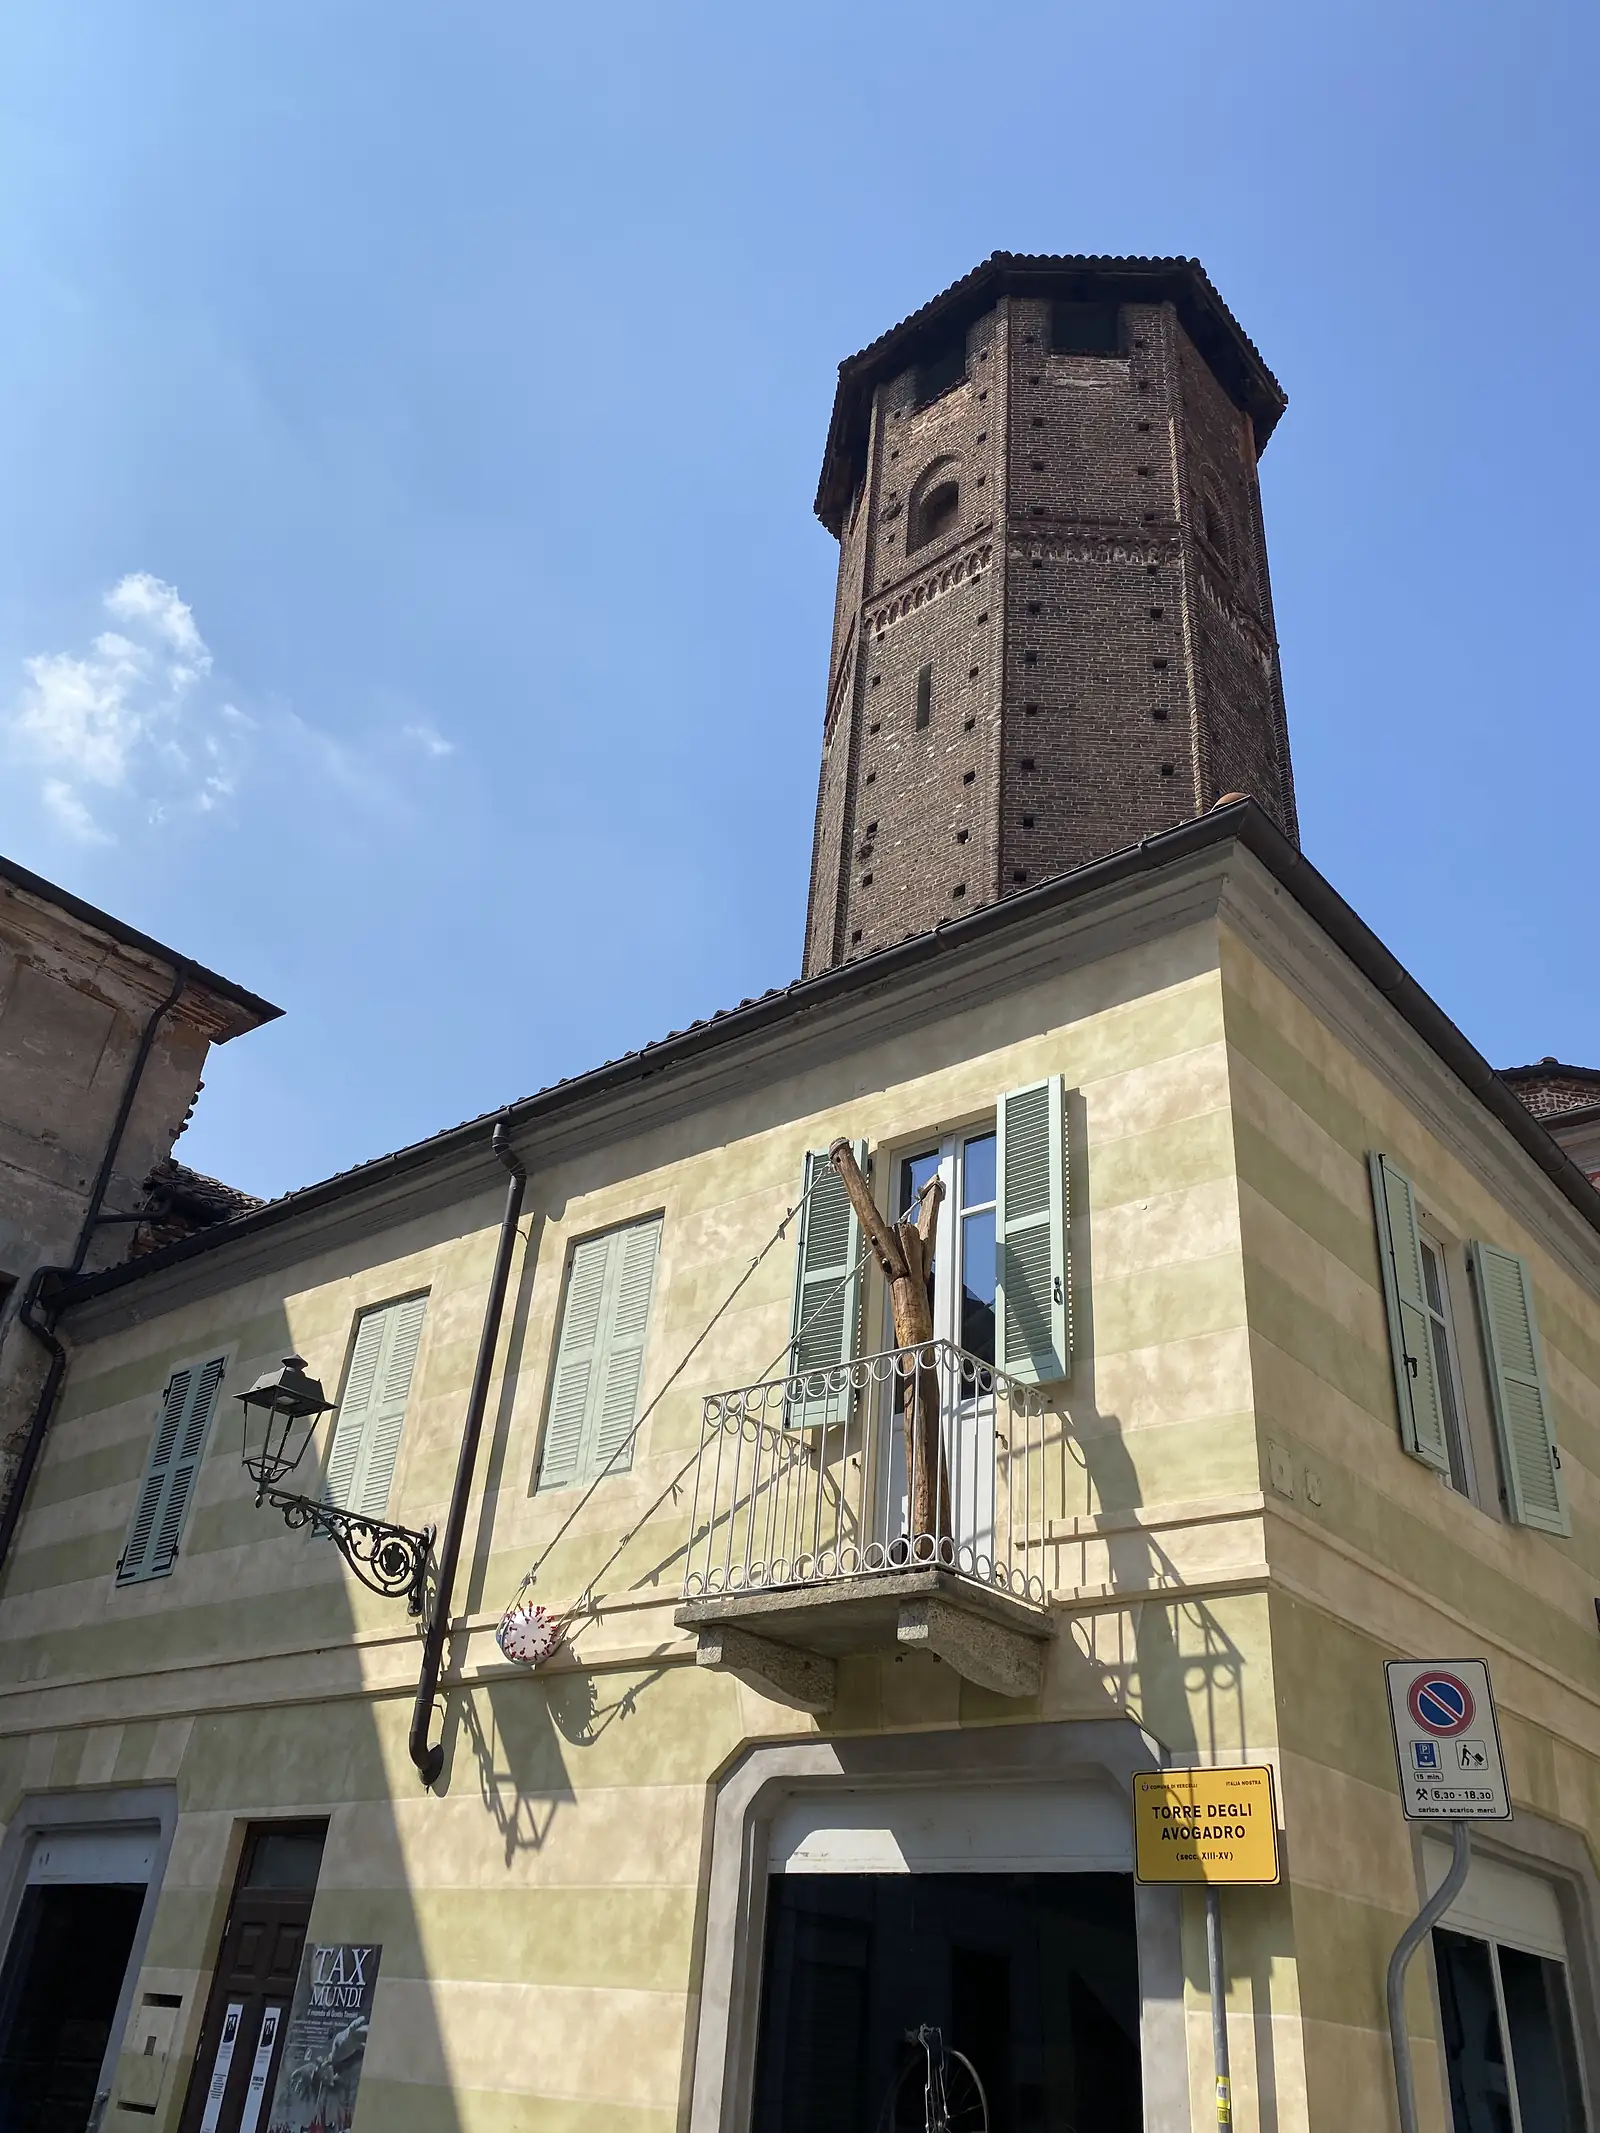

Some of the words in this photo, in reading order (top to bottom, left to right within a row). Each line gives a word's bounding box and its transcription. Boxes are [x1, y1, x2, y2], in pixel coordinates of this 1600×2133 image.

[1434, 1790, 1455, 1799] 6.30
[1464, 1790, 1491, 1799] 18.30
[1152, 1805, 1202, 1819] TORRE
[1208, 1803, 1252, 1817] DEGLI
[1477, 1806, 1496, 1814] merci
[1161, 1825, 1246, 1840] AVOGADRO
[1176, 1852, 1199, 1861] (secc.
[1201, 1851, 1233, 1861] XIII-XV)
[313, 1947, 371, 1986] TAX
[309, 1987, 363, 2007] MUNDI
